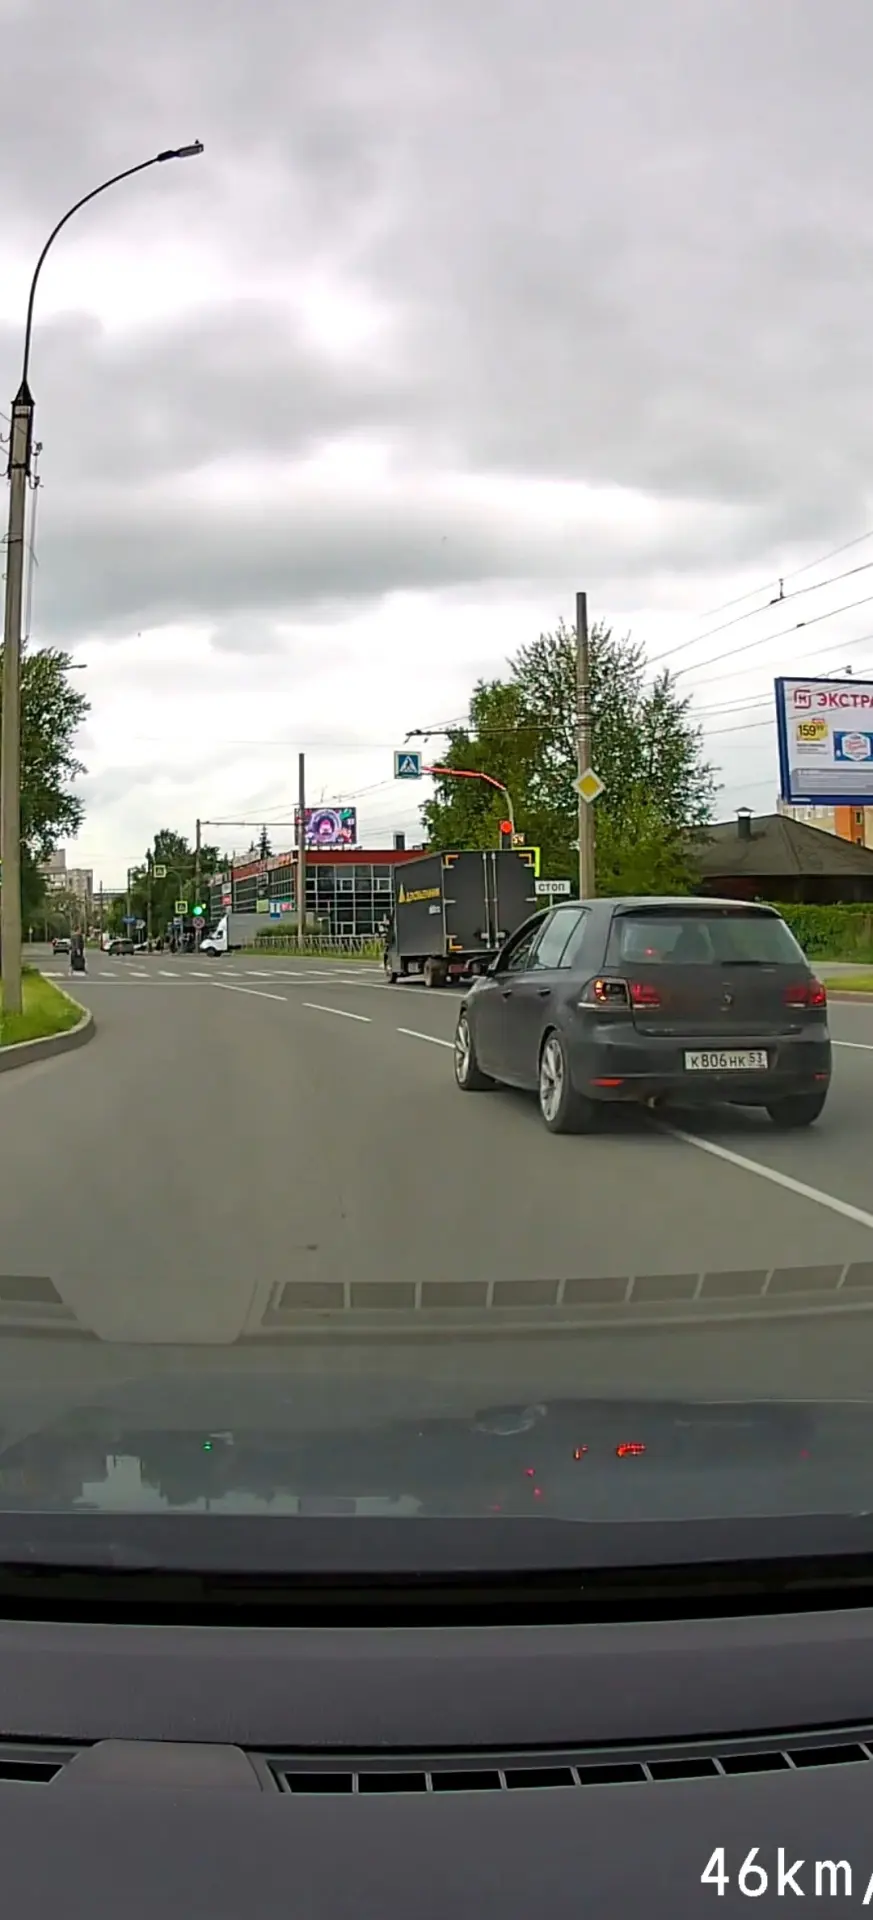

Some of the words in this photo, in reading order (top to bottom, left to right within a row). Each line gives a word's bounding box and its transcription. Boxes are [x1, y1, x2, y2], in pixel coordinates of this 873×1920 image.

[798, 724, 816, 737] 159
[538, 883, 566, 892] СТОП
[749, 1052, 762, 1063] 53
